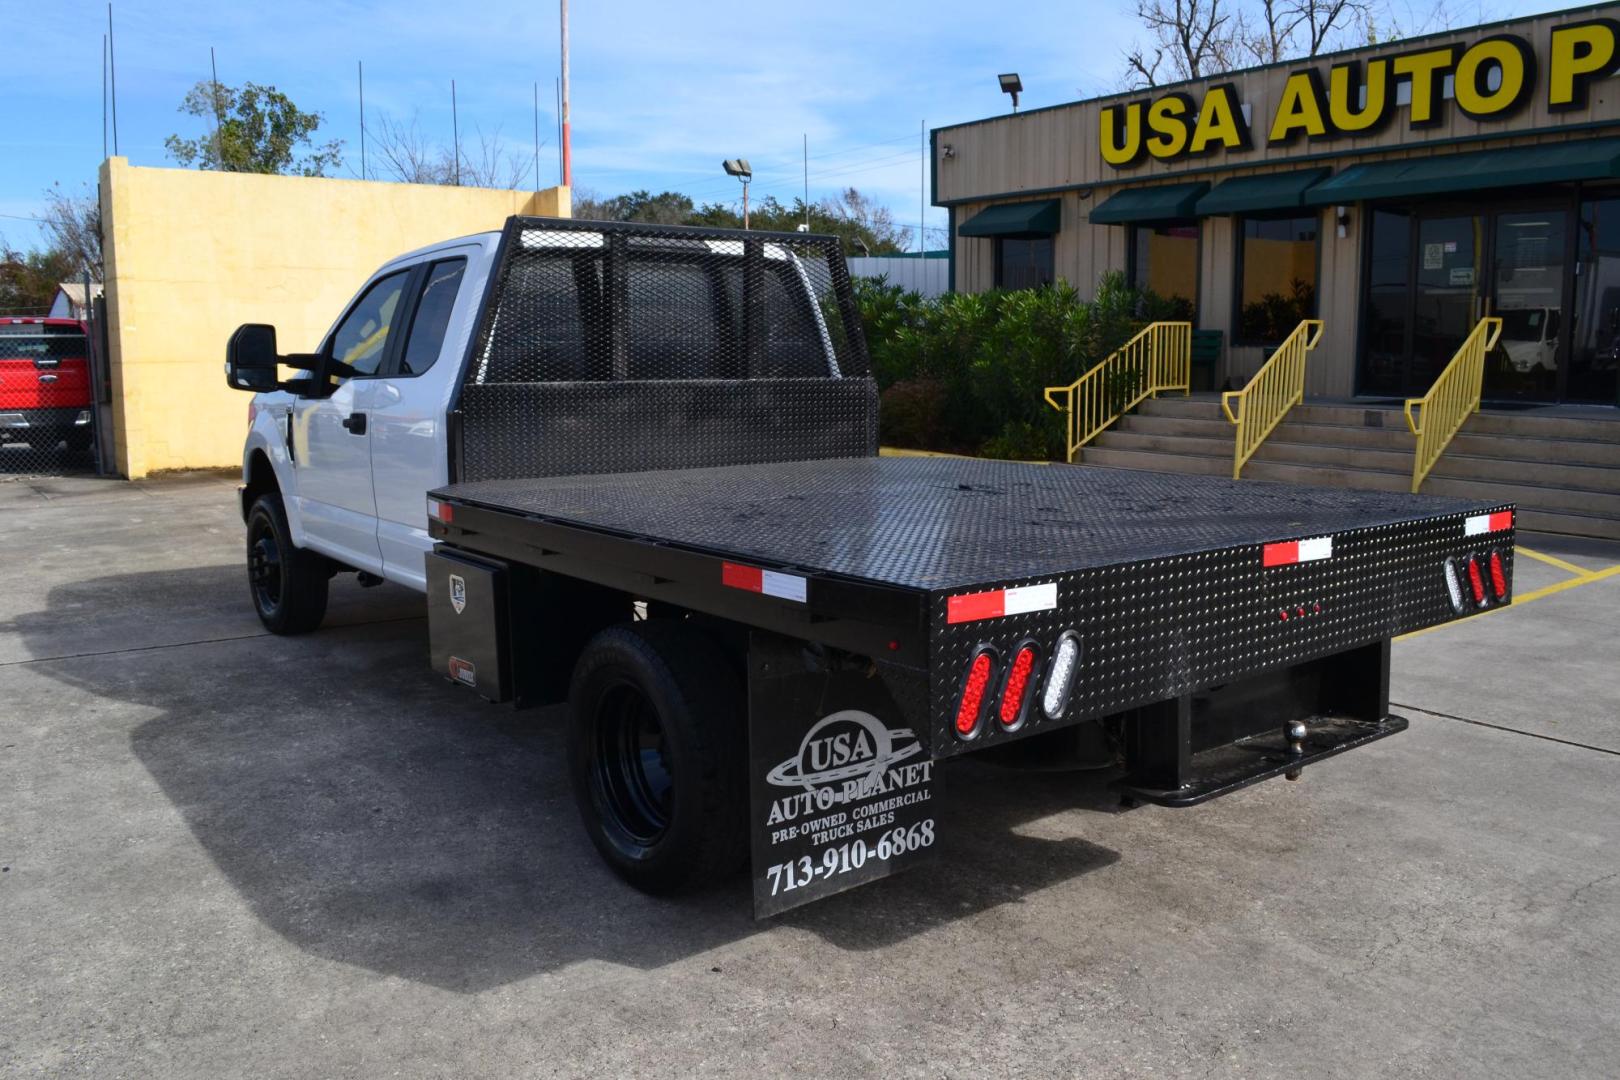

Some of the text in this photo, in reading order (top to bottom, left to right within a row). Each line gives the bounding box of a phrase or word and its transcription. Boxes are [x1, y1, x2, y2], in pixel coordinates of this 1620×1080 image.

[1100, 85, 1241, 165] USA
[1270, 41, 1524, 141] AUTO
[809, 729, 873, 771] USA
[771, 789, 931, 845] PRE-OWNED COMMERCIAL
[812, 811, 895, 846] TRUCK SALES
[766, 818, 935, 896] 713-910-6868
